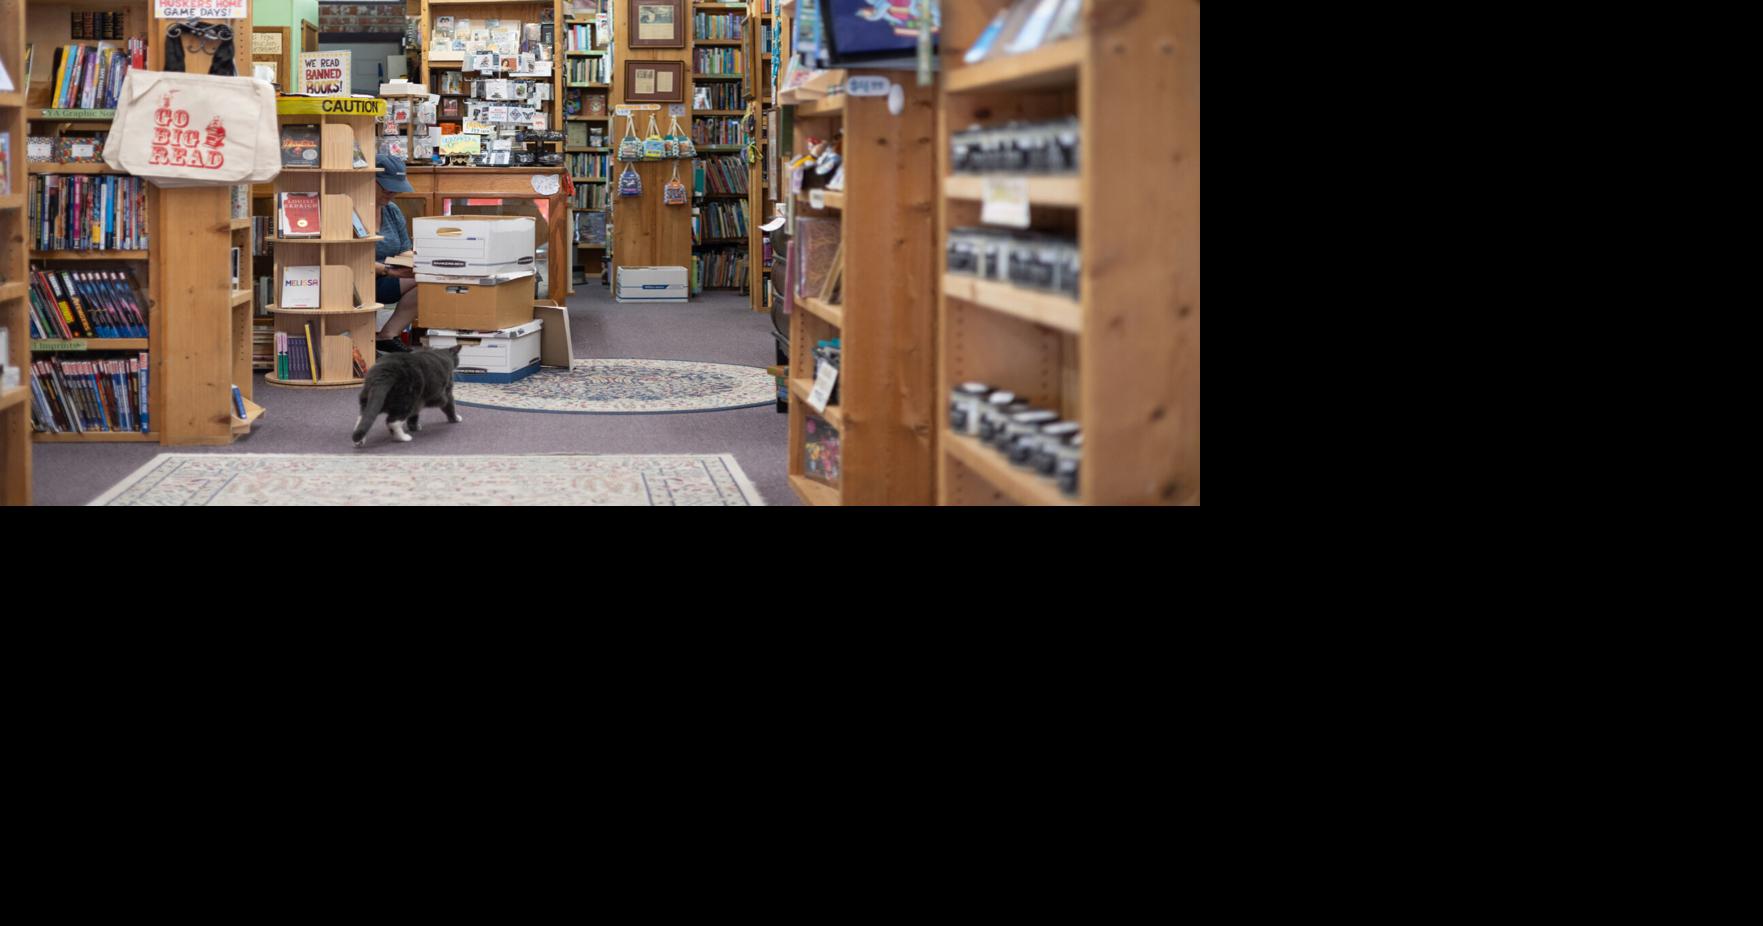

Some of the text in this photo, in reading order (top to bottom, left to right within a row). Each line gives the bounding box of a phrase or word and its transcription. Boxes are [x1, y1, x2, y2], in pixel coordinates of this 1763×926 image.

[216, 0, 243, 8] HOME
[163, 7, 232, 16] GAME DAYS!
[305, 58, 340, 67] WE READ
[306, 68, 342, 80] BANNED
[306, 80, 343, 94] BOOKS!
[322, 99, 378, 113] CAUTION
[47, 109, 60, 117] YA
[62, 109, 95, 119] Graphic
[154, 107, 190, 129] GO
[152, 127, 200, 149] BIG
[148, 146, 225, 170] READ
[285, 279, 319, 287] MELISSA
